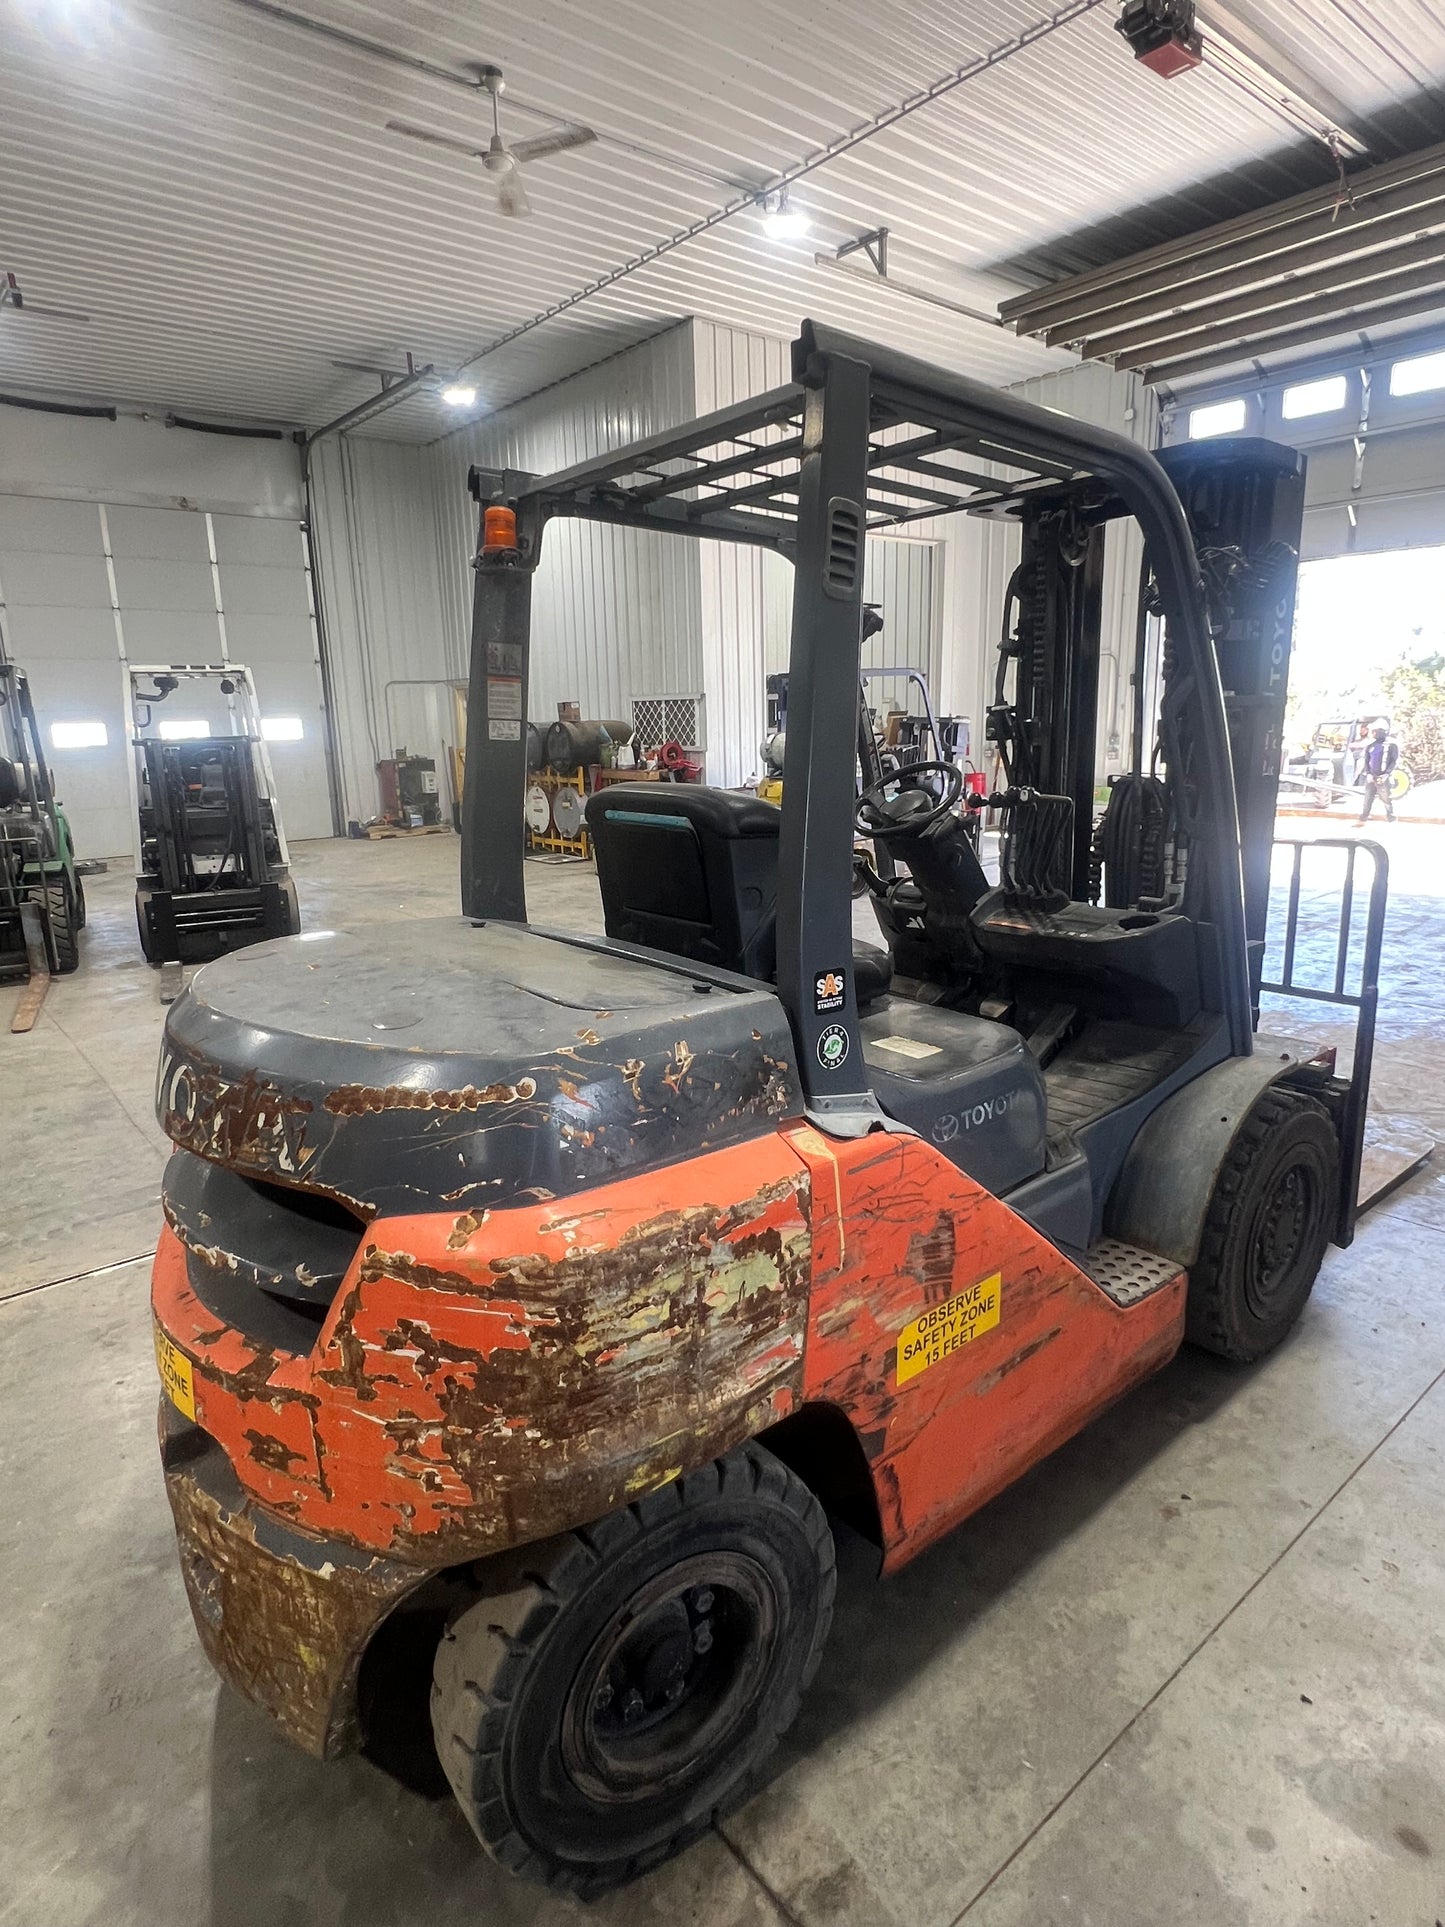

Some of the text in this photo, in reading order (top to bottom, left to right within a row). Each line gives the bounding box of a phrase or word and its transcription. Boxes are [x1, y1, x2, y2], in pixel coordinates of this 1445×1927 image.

[816, 973, 844, 998] SAS
[817, 1000, 843, 1010] STABILITY
[822, 1054, 845, 1067] FINAL
[903, 1294, 995, 1361] SAFETY ZONE
[917, 1285, 981, 1334] OBSERVE
[925, 1323, 977, 1366] 15 FEET
[163, 1356, 189, 1397] ZONE
